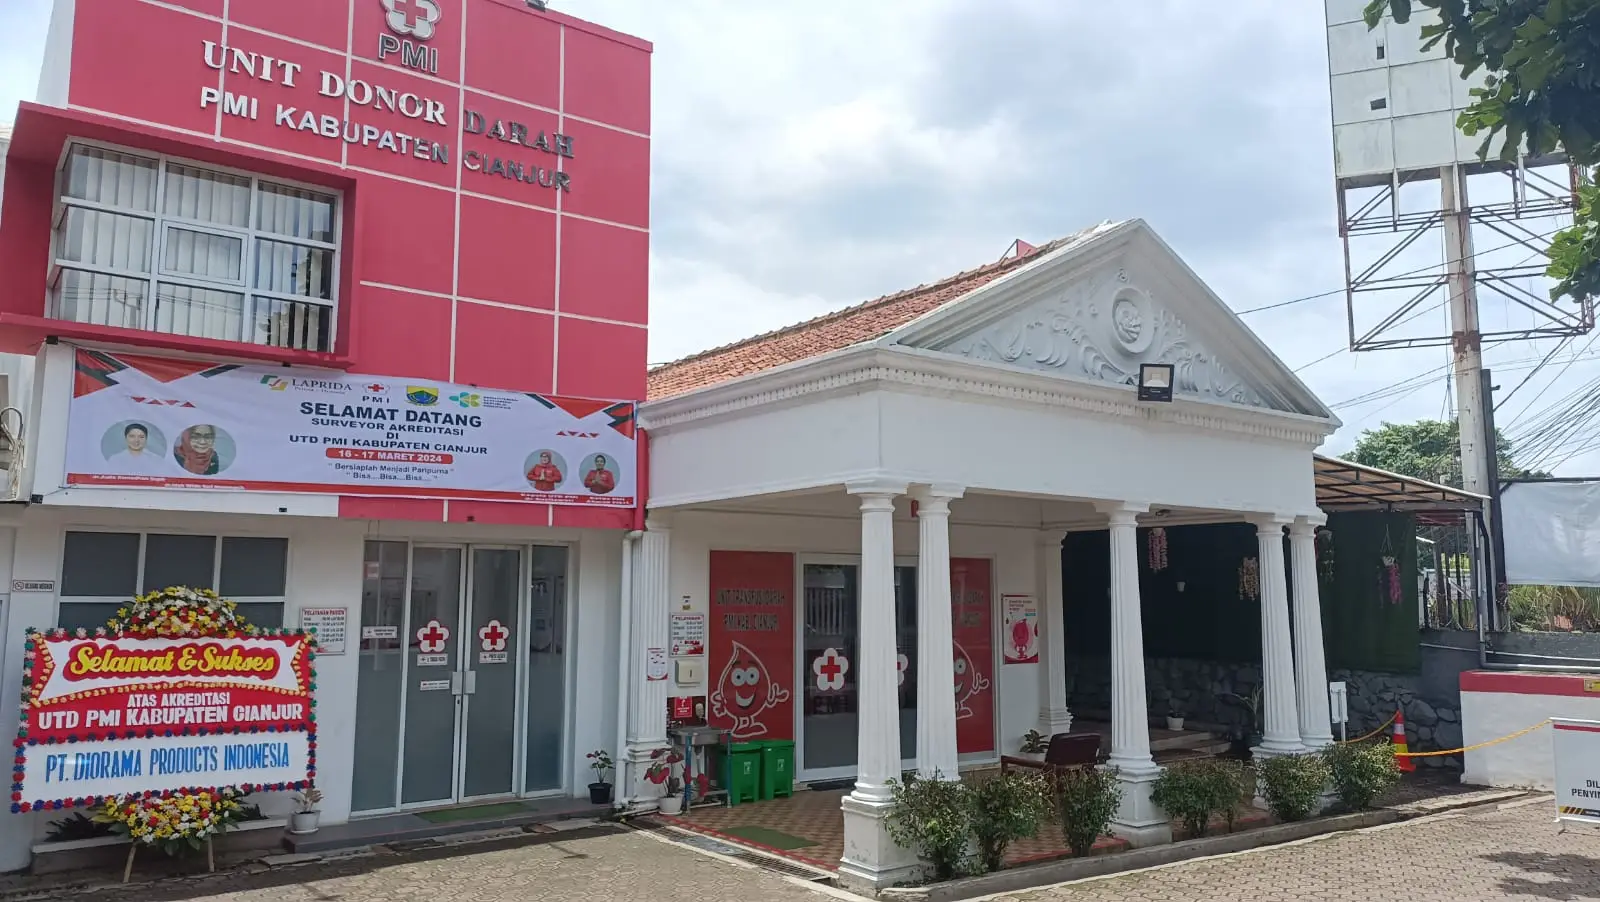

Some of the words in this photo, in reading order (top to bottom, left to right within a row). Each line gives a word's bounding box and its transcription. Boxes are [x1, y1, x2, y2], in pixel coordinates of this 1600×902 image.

[378, 33, 439, 73] PMI
[202, 39, 301, 88] UNIT
[318, 69, 448, 126] DONOR
[465, 108, 575, 159] DARAH
[200, 86, 258, 121] PMI
[275, 104, 449, 165] KABUPATEN
[463, 150, 572, 192] CIANJUR
[292, 378, 352, 391] LAPRIDA
[300, 401, 399, 421] SELAMAT
[406, 409, 482, 428] DATANG
[312, 417, 385, 431] SURVEYOR
[389, 423, 464, 436] AKREDITASI
[289, 434, 319, 444] UTD
[323, 436, 348, 446] PMI
[352, 439, 430, 451] KABUPATEN
[434, 443, 488, 455] CIANJUR
[386, 431, 399, 440] DI
[338, 449, 352, 459] 16
[362, 450, 375, 460] 17
[377, 451, 415, 461] MARET
[417, 453, 442, 464] 2024
[70, 646, 174, 675] Selamat
[177, 647, 198, 672] &
[198, 646, 275, 673] Sukses
[127, 692, 158, 708] ATAS
[161, 691, 230, 707] AKREDITASI
[38, 710, 80, 730] UTD
[85, 709, 121, 728] PMI
[126, 706, 228, 727] KABUPATEN
[233, 703, 303, 723] CIANJUR
[45, 753, 70, 784] PT.
[74, 750, 143, 781] DIORAMA
[150, 745, 218, 776] PRODUCTS
[224, 742, 290, 771] INDONESIA
